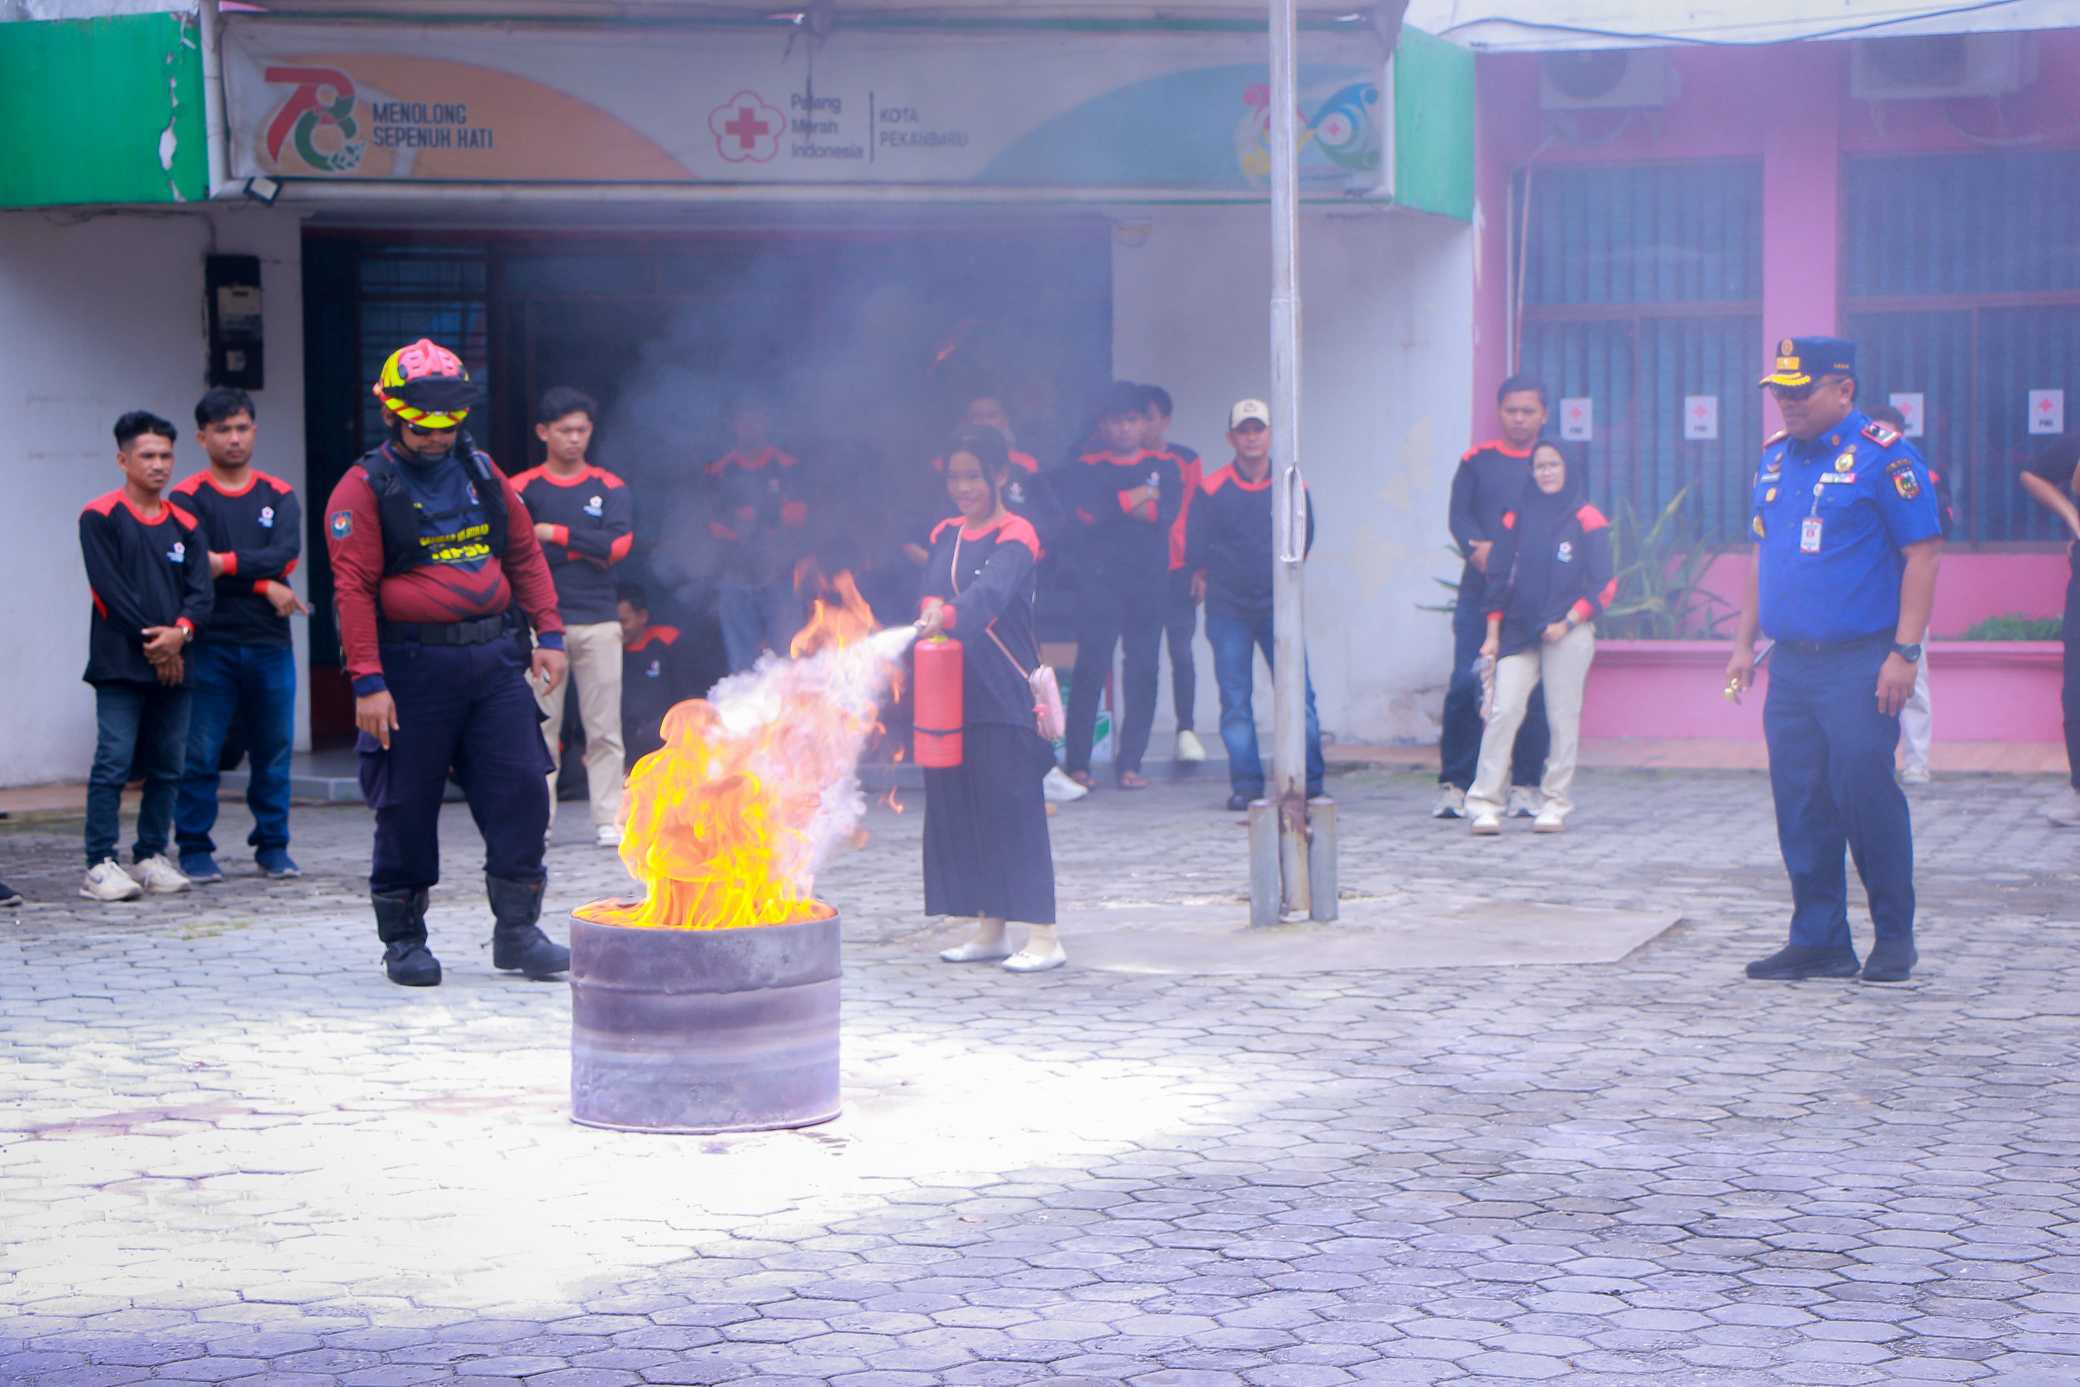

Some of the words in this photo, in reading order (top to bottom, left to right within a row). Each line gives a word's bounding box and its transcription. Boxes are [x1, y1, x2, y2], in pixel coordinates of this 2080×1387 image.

[373, 103, 467, 124] MENOLONG
[880, 107, 921, 123] KOTA
[373, 127, 452, 147] SEPENUH
[457, 128, 494, 148] HATI
[880, 131, 970, 147] PEKANBARU
[791, 143, 865, 159] Indonesia
